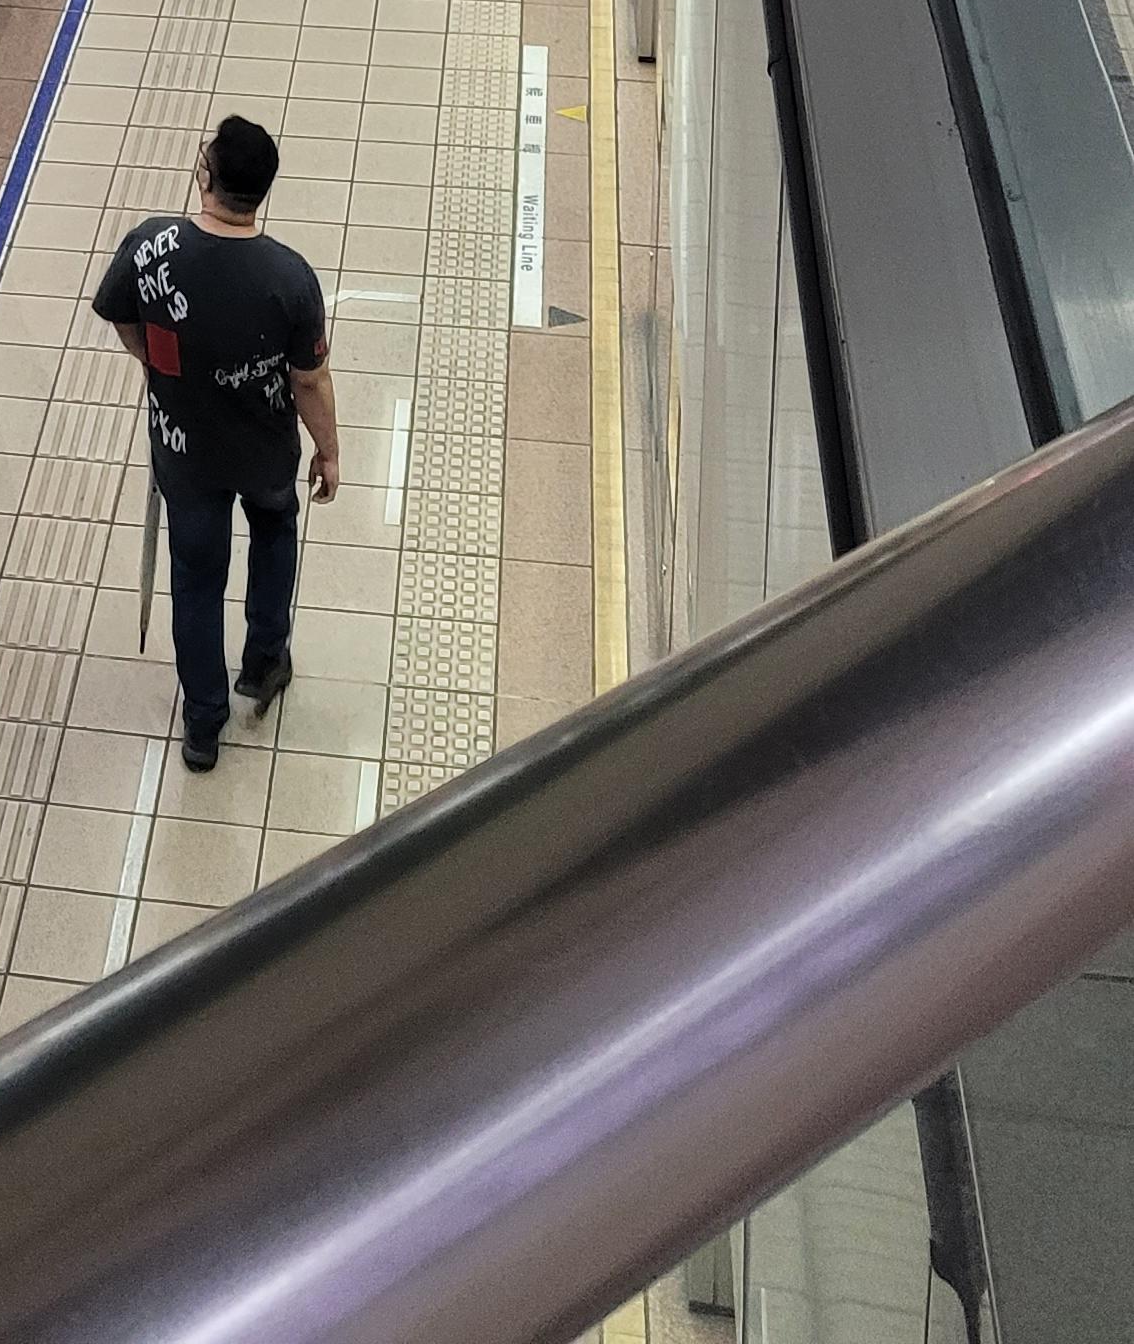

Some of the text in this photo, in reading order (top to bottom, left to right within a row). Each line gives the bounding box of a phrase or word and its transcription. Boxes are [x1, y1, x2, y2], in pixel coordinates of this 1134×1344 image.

[133, 224, 181, 273] NEVER
[517, 194, 539, 272] Waiting Line
[137, 262, 176, 304] GIVE
